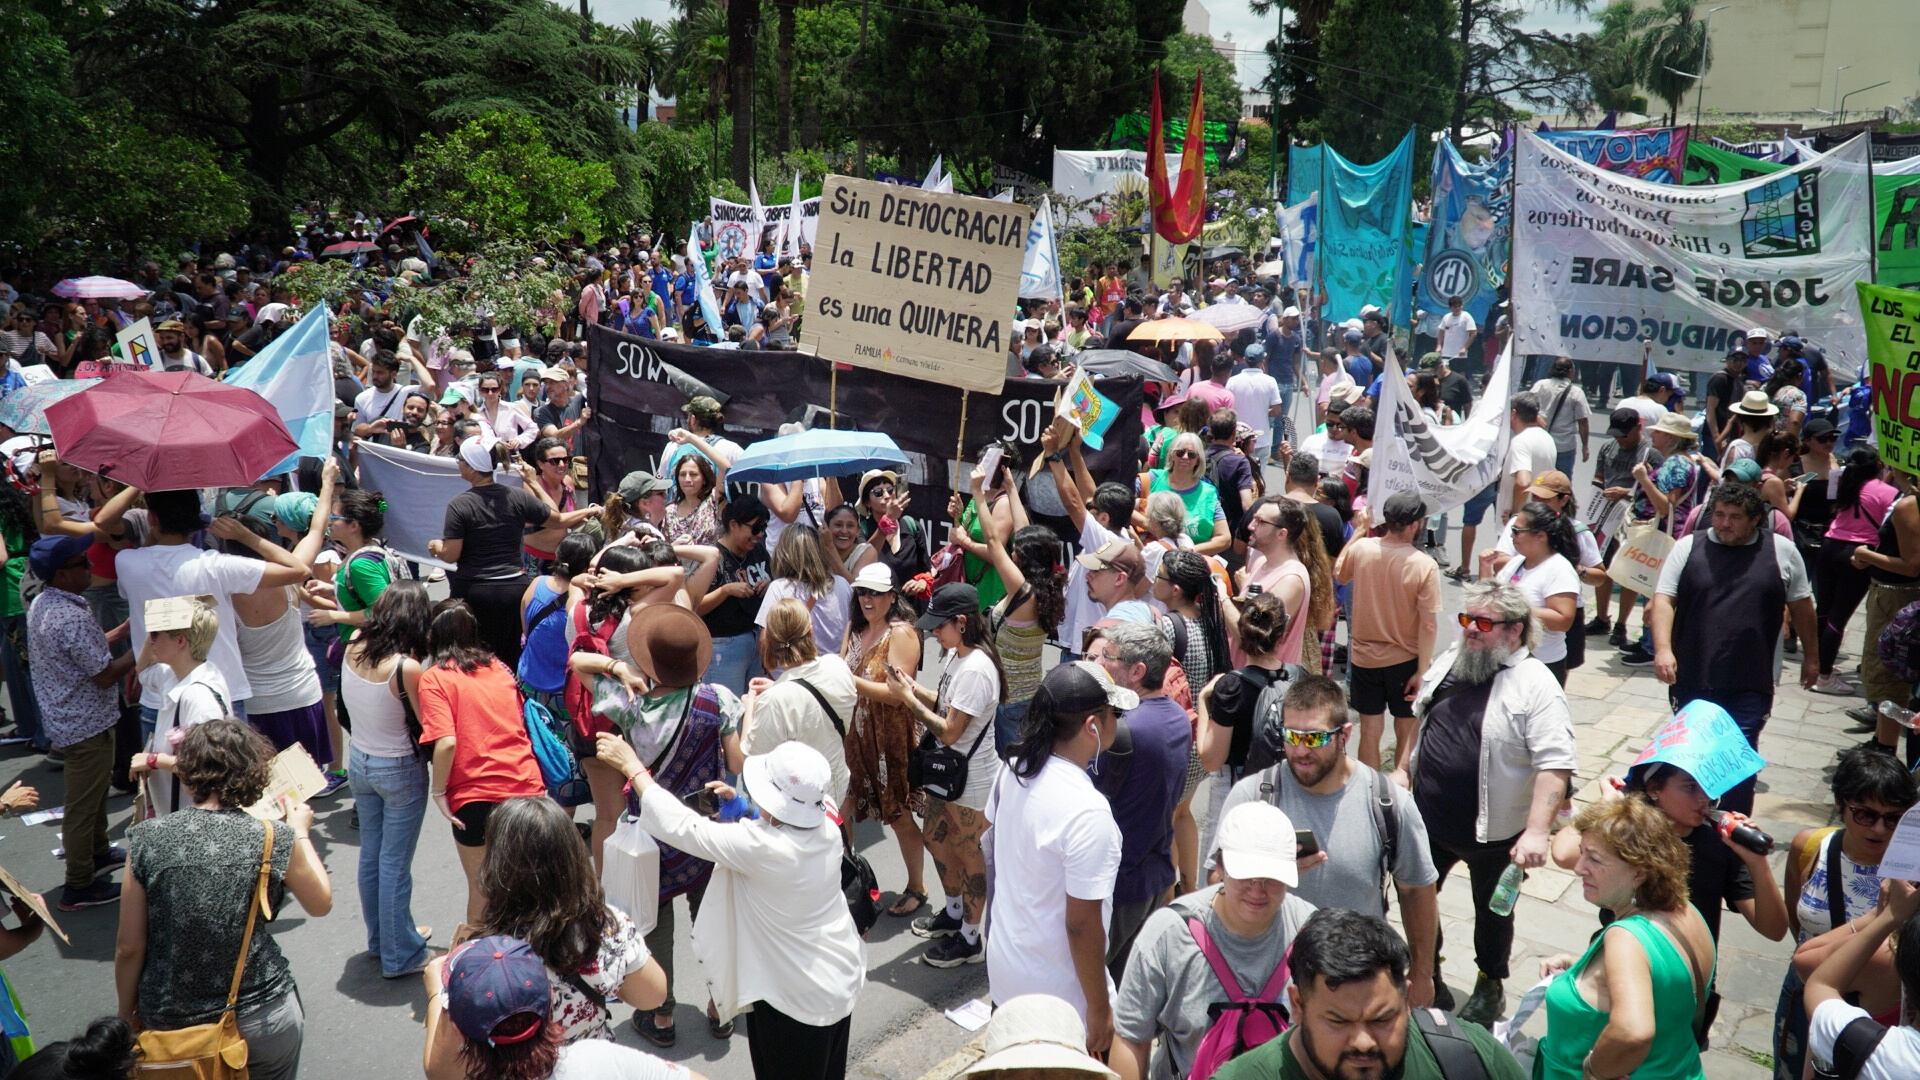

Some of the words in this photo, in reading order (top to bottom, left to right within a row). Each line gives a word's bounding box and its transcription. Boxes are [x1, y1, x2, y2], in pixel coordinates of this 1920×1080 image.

[1095, 156, 1145, 171] FREN
[714, 204, 753, 223] SINDICA
[830, 186, 870, 219] Sin
[879, 193, 1023, 248] DEMOCRACIA
[830, 232, 854, 268] la
[871, 242, 992, 295] LIBERTAD
[1871, 296, 1904, 318] LOS
[819, 296, 843, 318] es
[851, 302, 892, 327] una
[899, 300, 1000, 353] QUIMERA
[1890, 324, 1915, 344] EL
[1881, 419, 1903, 442] QUE
[1886, 443, 1900, 463] NO
